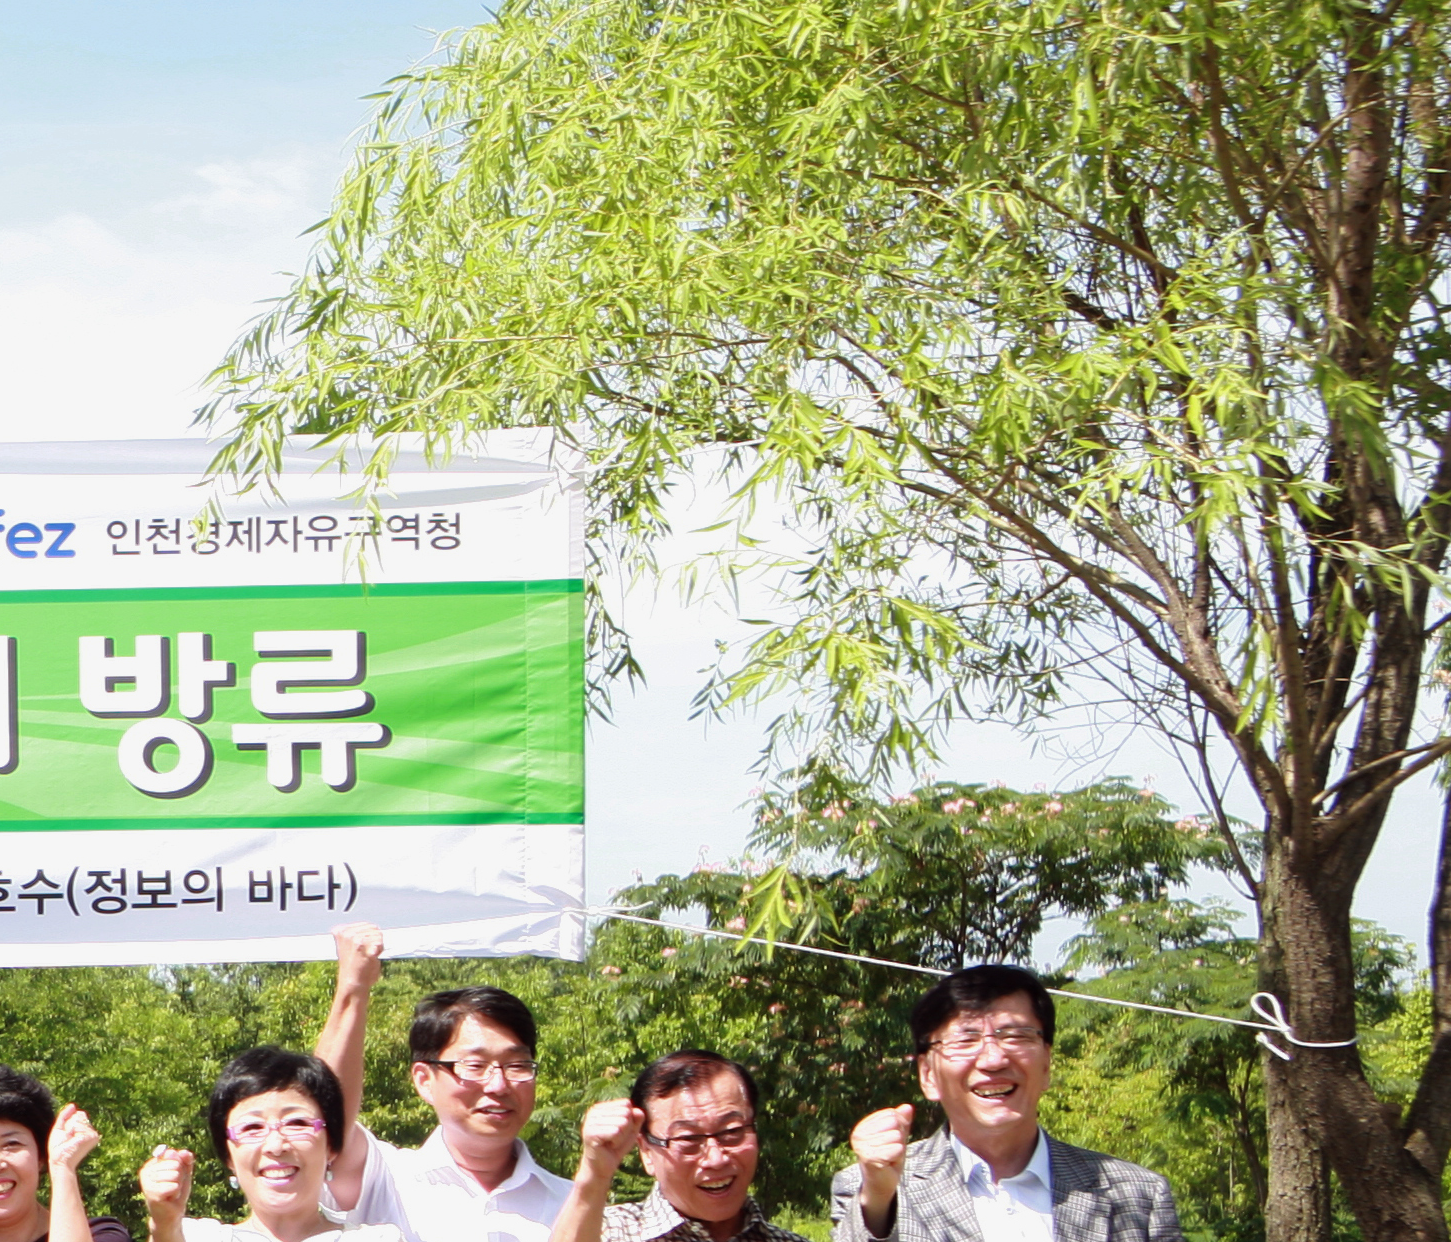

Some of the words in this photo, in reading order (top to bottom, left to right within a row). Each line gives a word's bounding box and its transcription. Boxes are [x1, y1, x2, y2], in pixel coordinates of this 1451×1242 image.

[106, 511, 462, 556] 인천경제자유구역청
[78, 628, 393, 799] 방류
[248, 862, 359, 913] 바다)
